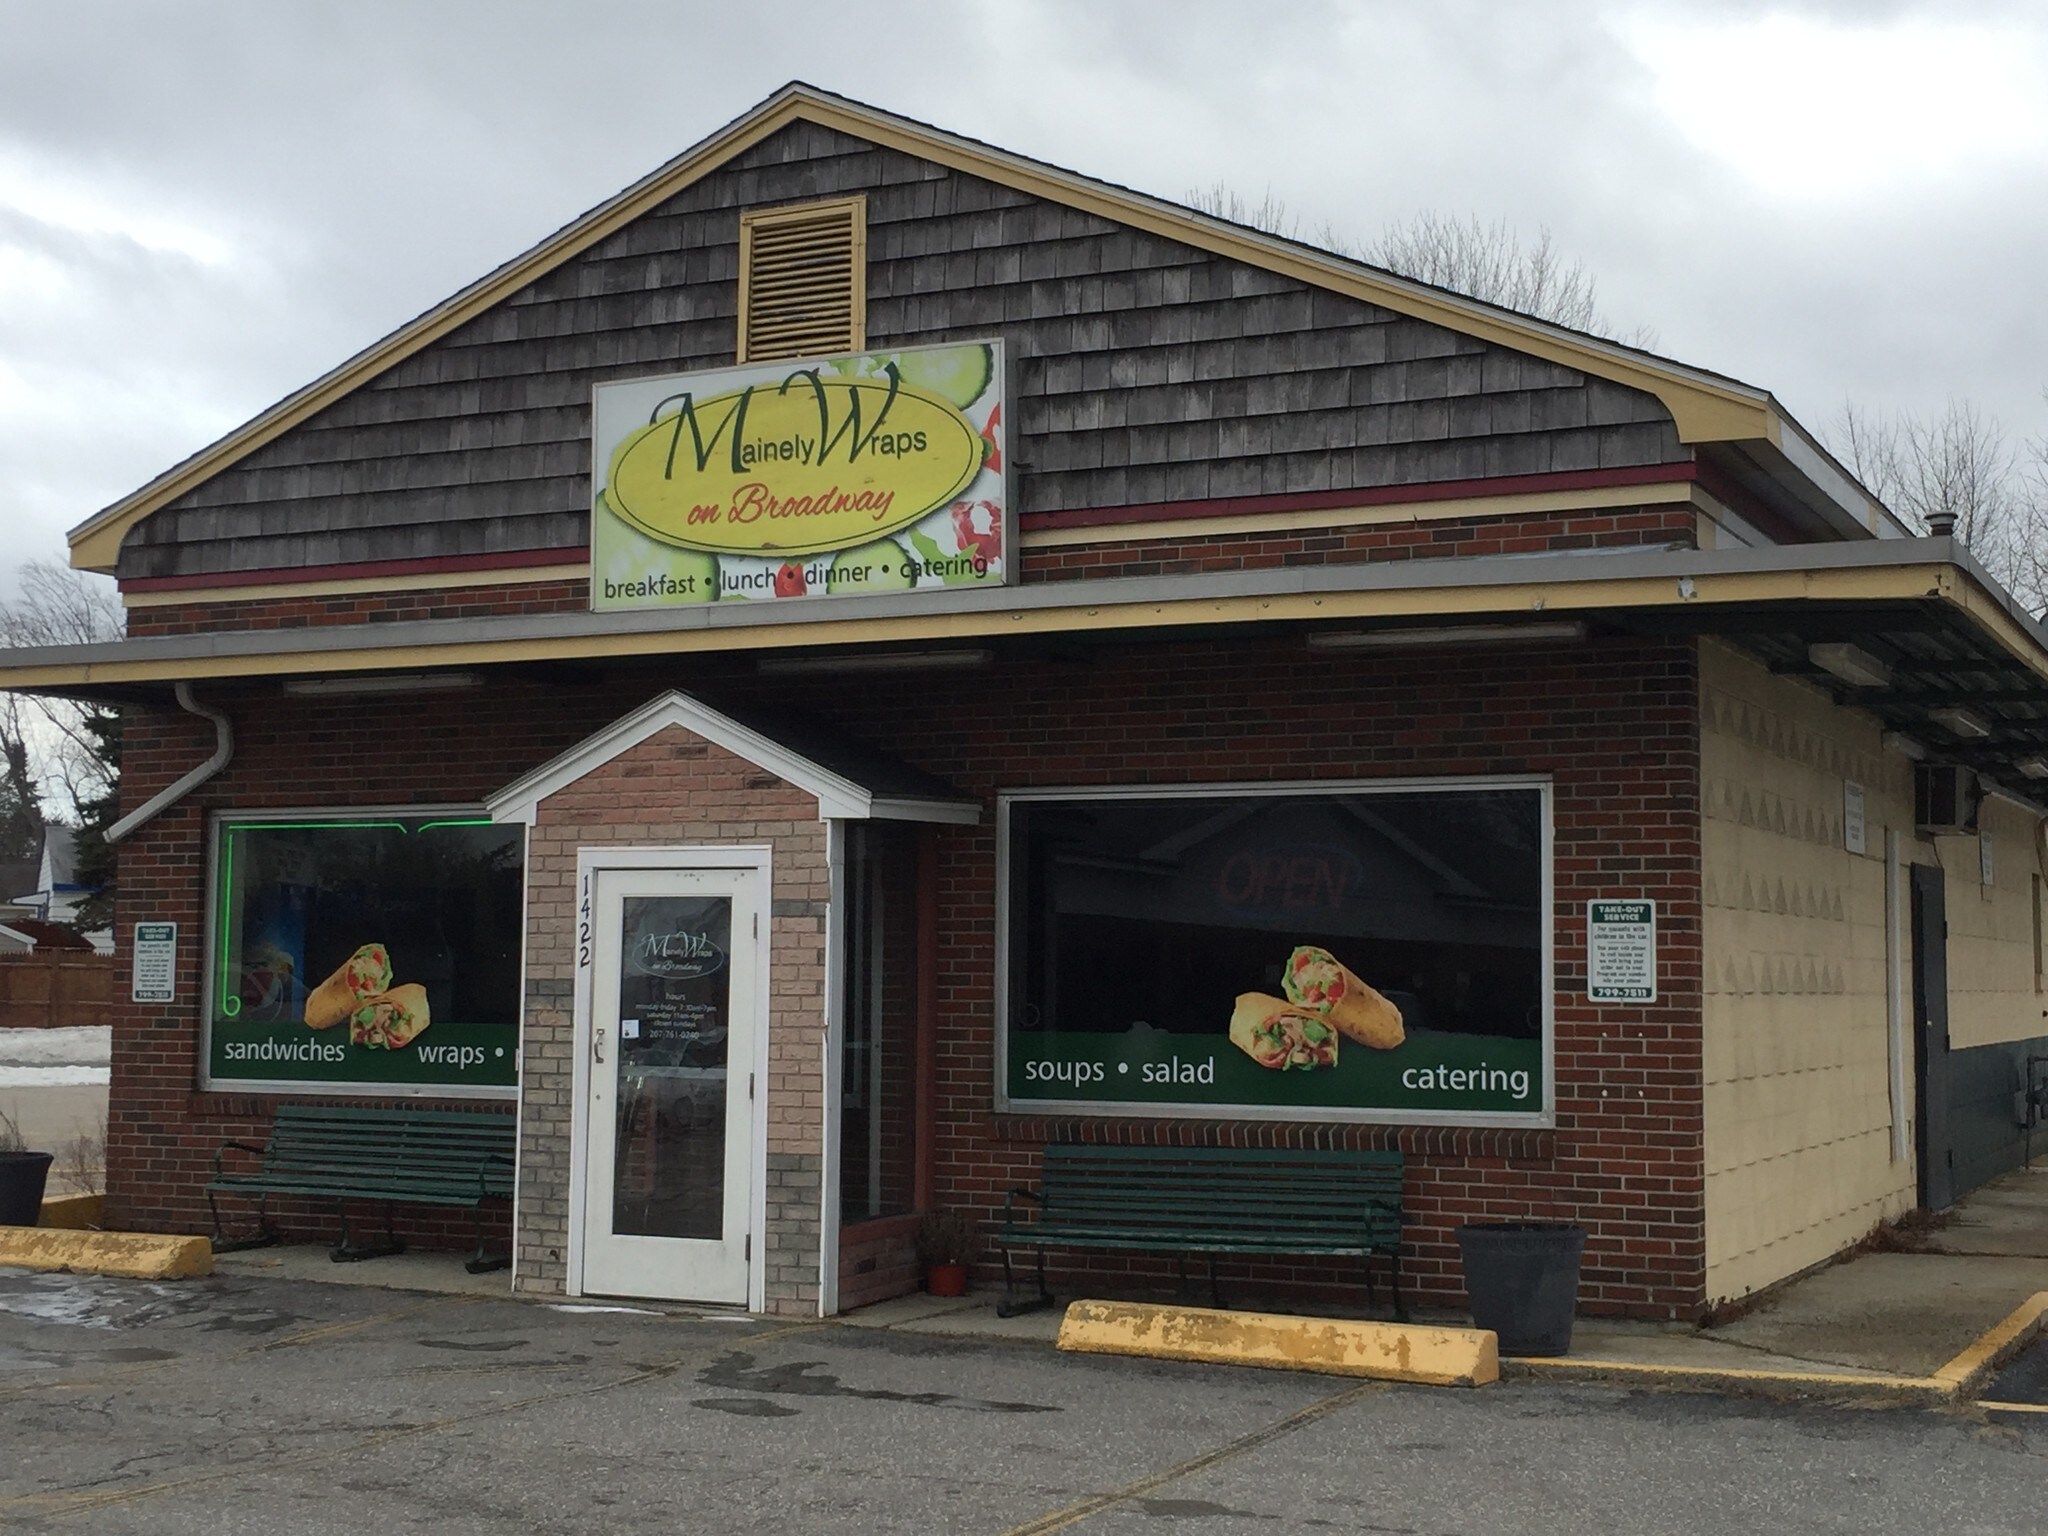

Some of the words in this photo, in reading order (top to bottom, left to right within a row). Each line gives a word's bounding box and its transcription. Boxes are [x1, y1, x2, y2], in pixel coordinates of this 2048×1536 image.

[650, 385, 814, 480] Mainely
[779, 361, 927, 467] Wraps
[687, 500, 721, 526] on
[728, 482, 895, 523] Broadway
[604, 573, 696, 600] breakfast
[722, 566, 776, 592] lunch
[804, 563, 872, 586] dinner
[899, 555, 988, 579] catering
[1219, 852, 1350, 907] OPEN
[580, 874, 592, 968] 1422
[224, 1037, 346, 1062] sandwiches
[418, 1043, 485, 1069] wraps
[1025, 1059, 1105, 1094] soups
[1141, 1056, 1215, 1084] salad
[1401, 1062, 1530, 1099] catering
